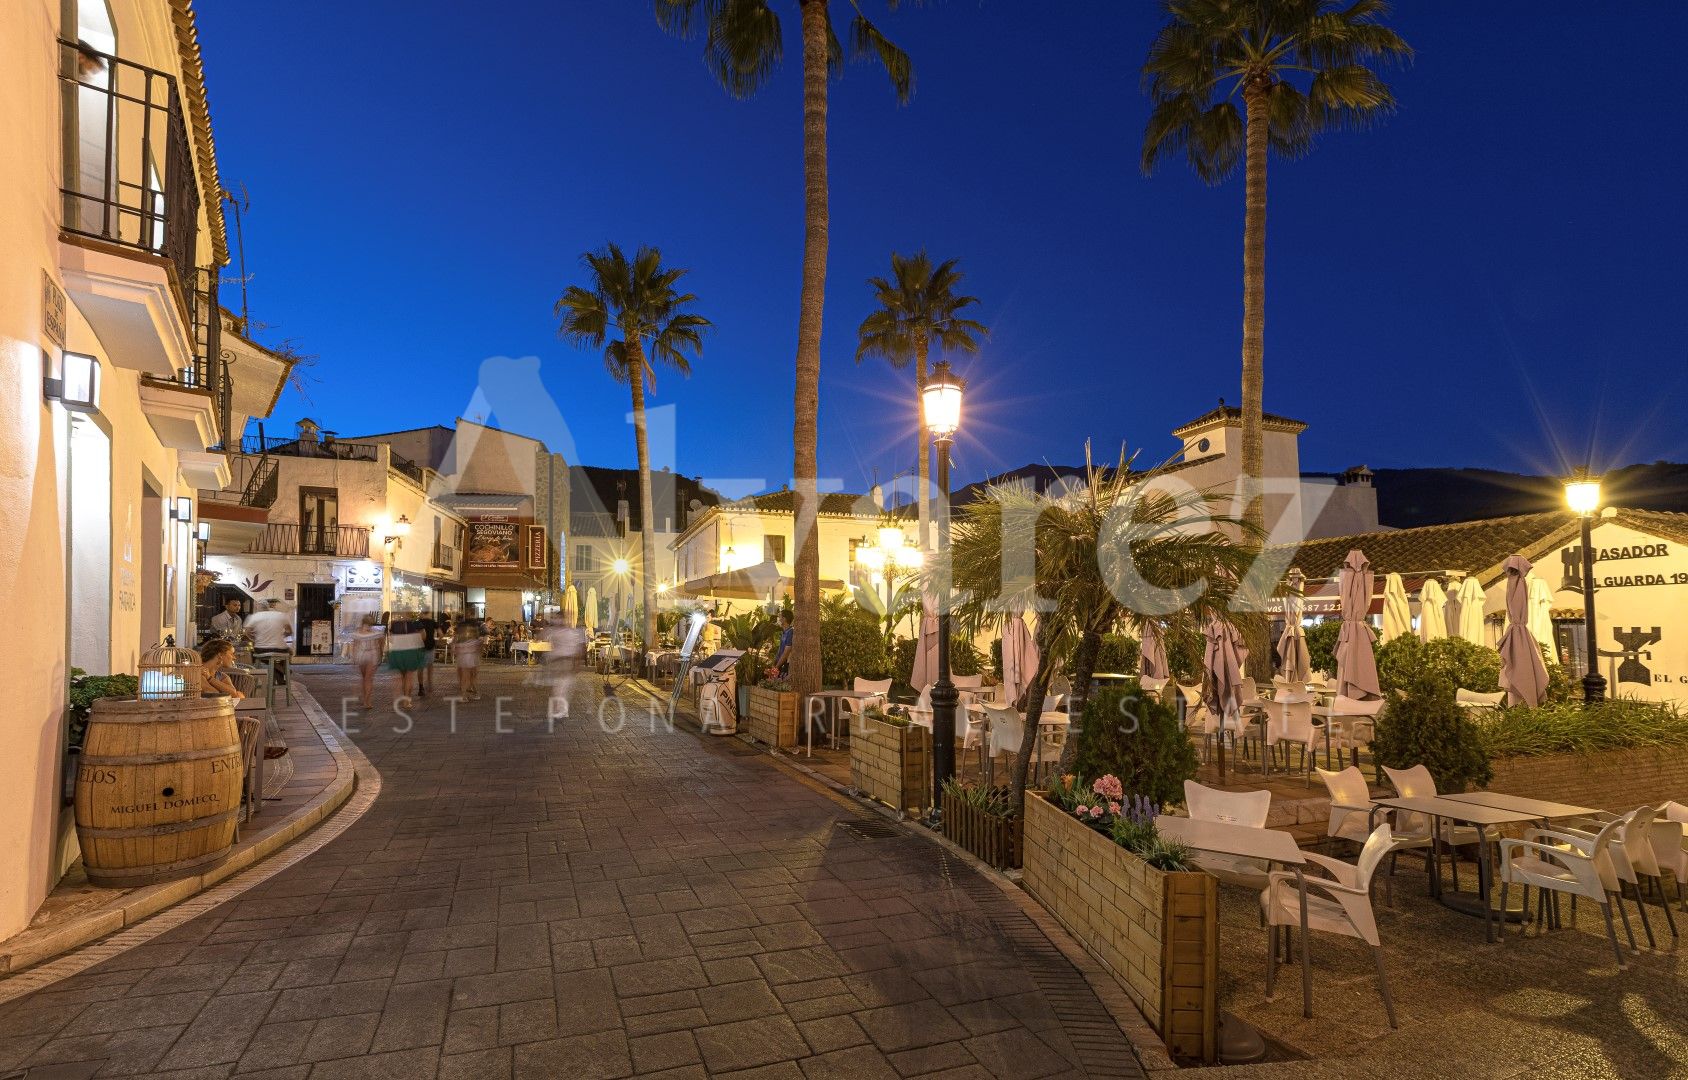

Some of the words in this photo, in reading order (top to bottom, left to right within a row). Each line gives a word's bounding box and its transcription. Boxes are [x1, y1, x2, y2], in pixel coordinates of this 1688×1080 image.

[1599, 543, 1669, 560] ASADOR
[1603, 574, 1666, 587] GUARDA
[1654, 674, 1673, 683] EL
[111, 802, 159, 814] MIGUEL
